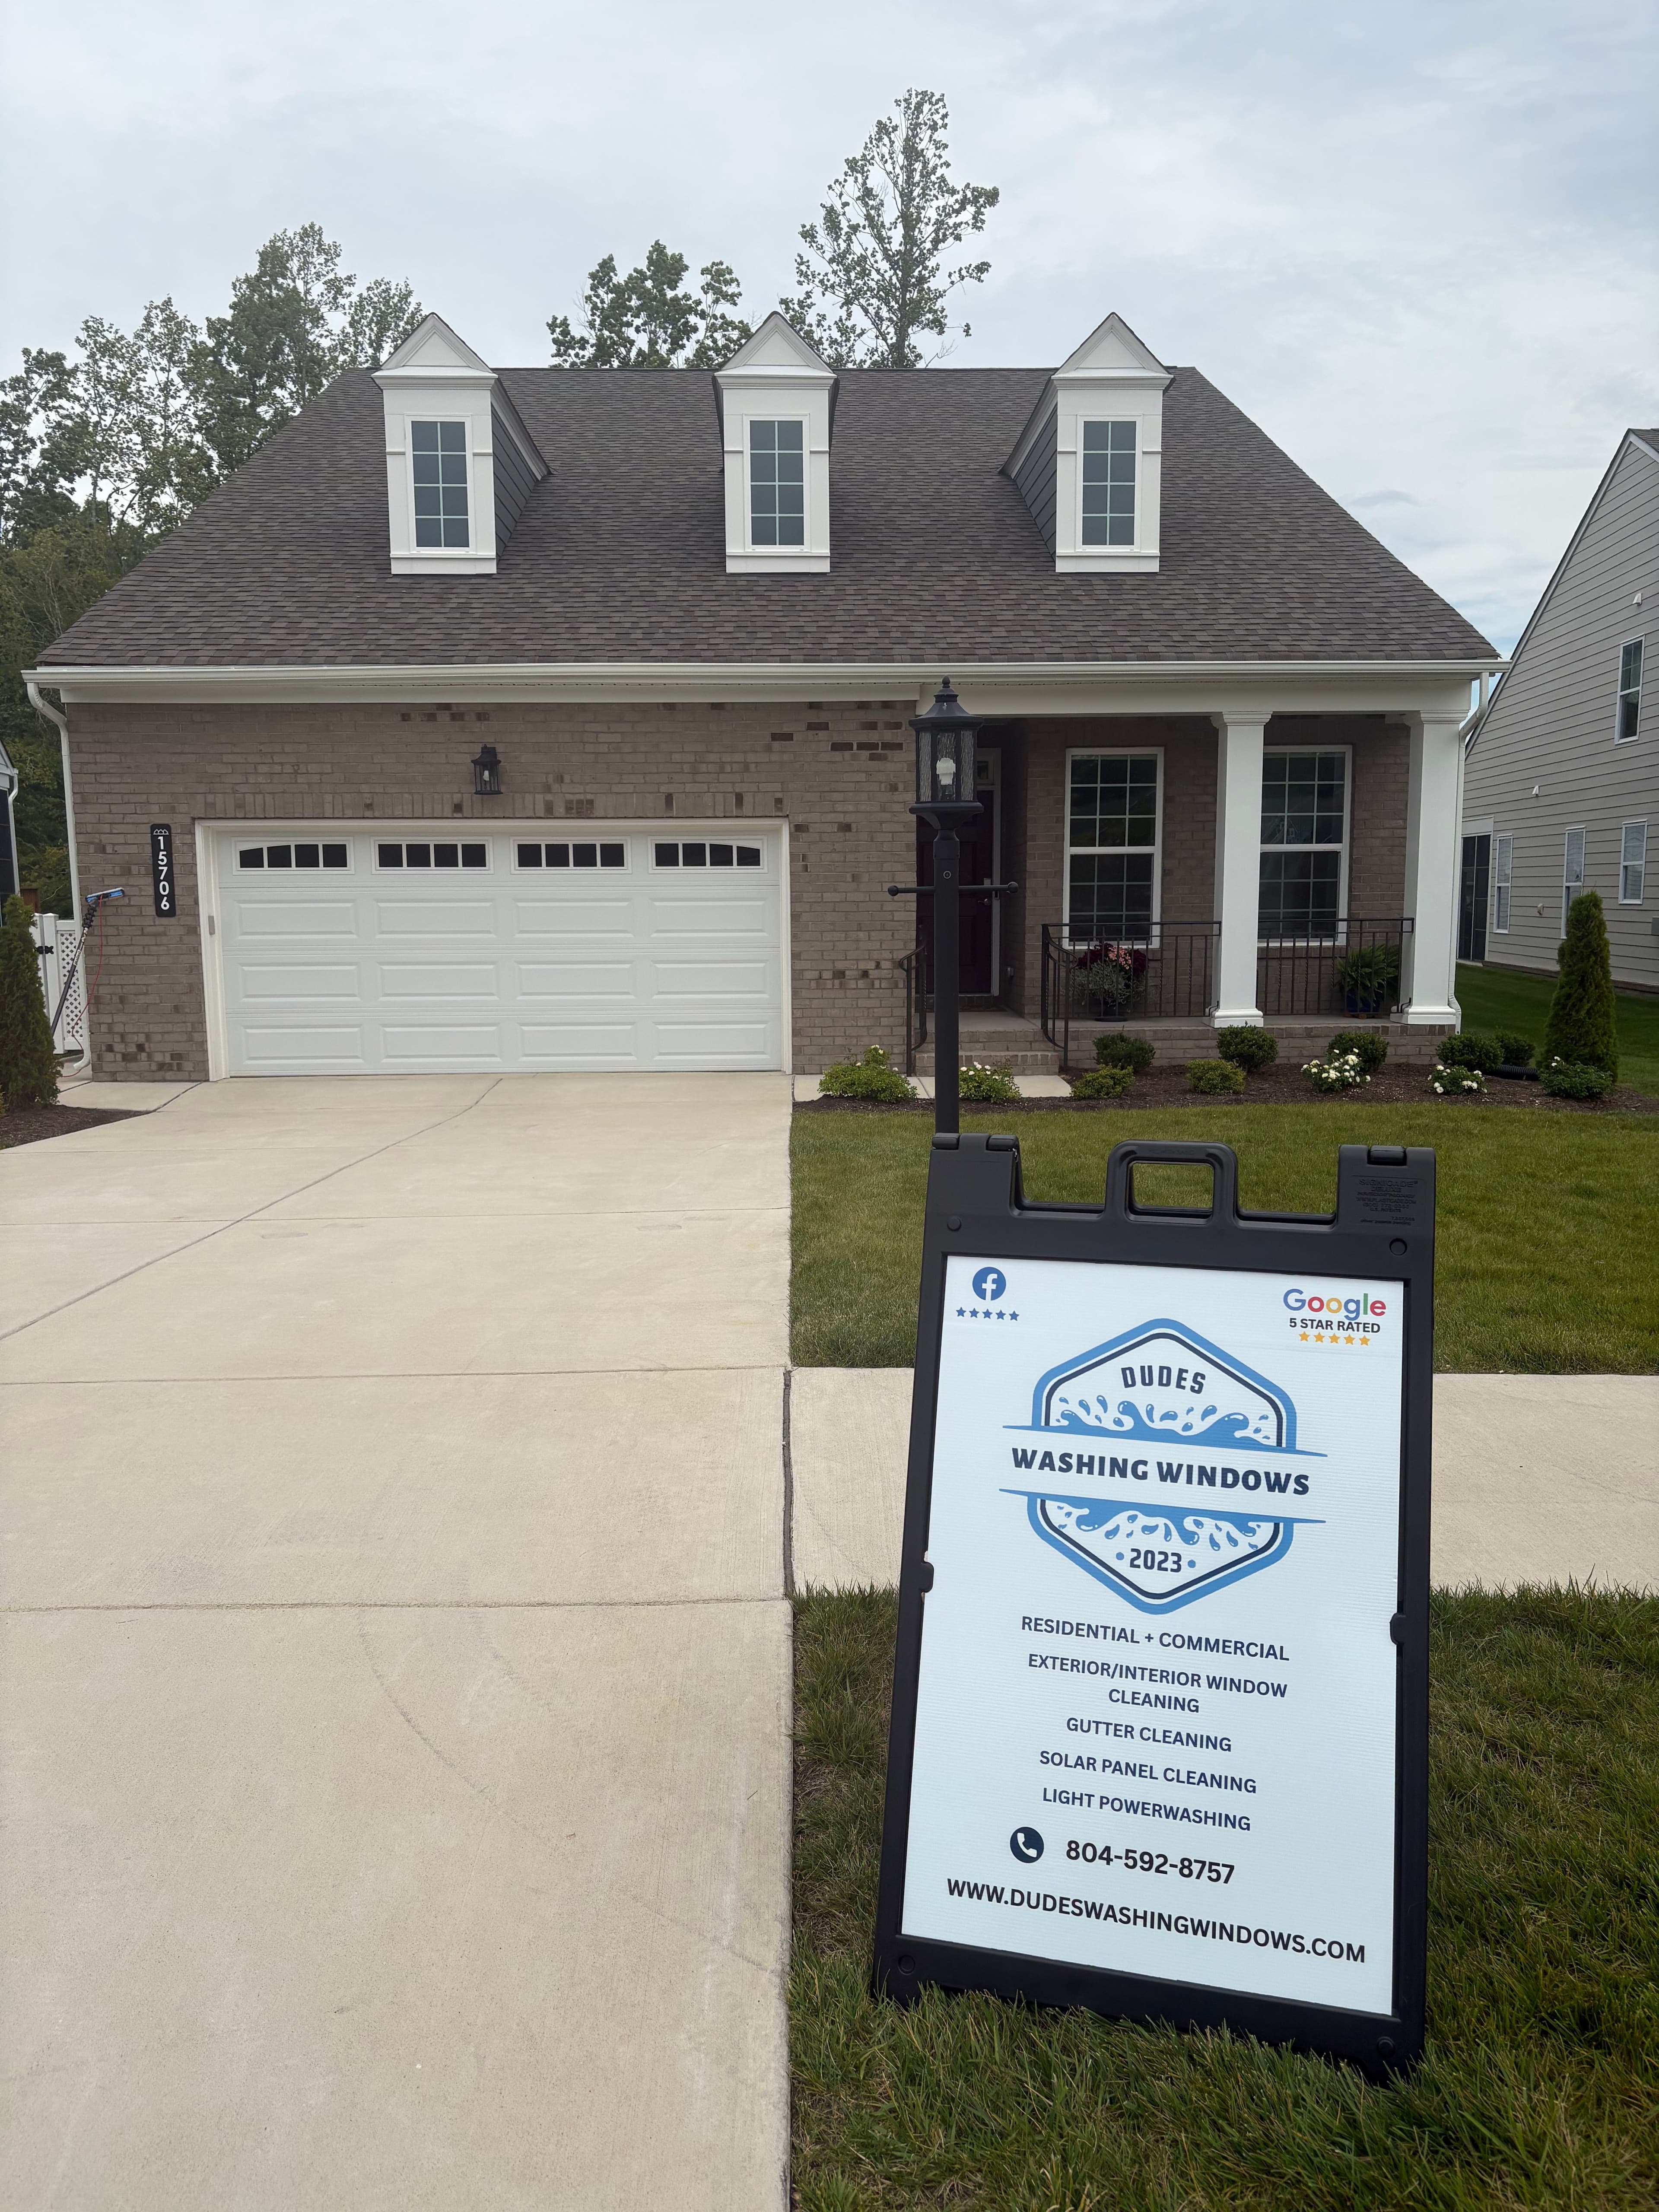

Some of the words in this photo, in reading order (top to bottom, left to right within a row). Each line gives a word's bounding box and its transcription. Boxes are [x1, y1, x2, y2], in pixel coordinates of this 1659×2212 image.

[157, 836, 170, 910] 15706
[1283, 1289, 1386, 1321] Google
[1289, 1318, 1297, 1328] 5
[1300, 1318, 1334, 1331] STAR
[1337, 1321, 1381, 1334] RATED
[1120, 1364, 1206, 1395] DUDES
[1011, 1447, 1149, 1481] WASHING
[1156, 1461, 1309, 1496] WINDOWS
[1129, 1548, 1182, 1573] 2023
[1021, 1615, 1141, 1644] RESIDENTIAL
[1144, 1633, 1154, 1643] +
[1159, 1632, 1290, 1662] COMMERCIAL
[1028, 1653, 1202, 1688] EXTERIOR/INTERIOR
[1205, 1674, 1288, 1698] WINDOW
[1108, 1688, 1200, 1713] CLEANING
[1066, 1717, 1135, 1740] GUTTER
[1139, 1726, 1232, 1753] CLEANING
[1039, 1750, 1097, 1772] SOLAR
[1101, 1758, 1159, 1780] PANEL
[1163, 1767, 1257, 1794] CLEANING
[1042, 1787, 1096, 1808] LIGHT
[1099, 1795, 1251, 1832] POWERWASHING
[1065, 1840, 1235, 1885] 804-592-8757
[947, 1878, 1365, 1964] WWW.DUDESWASHINGWINDOWS.COM
